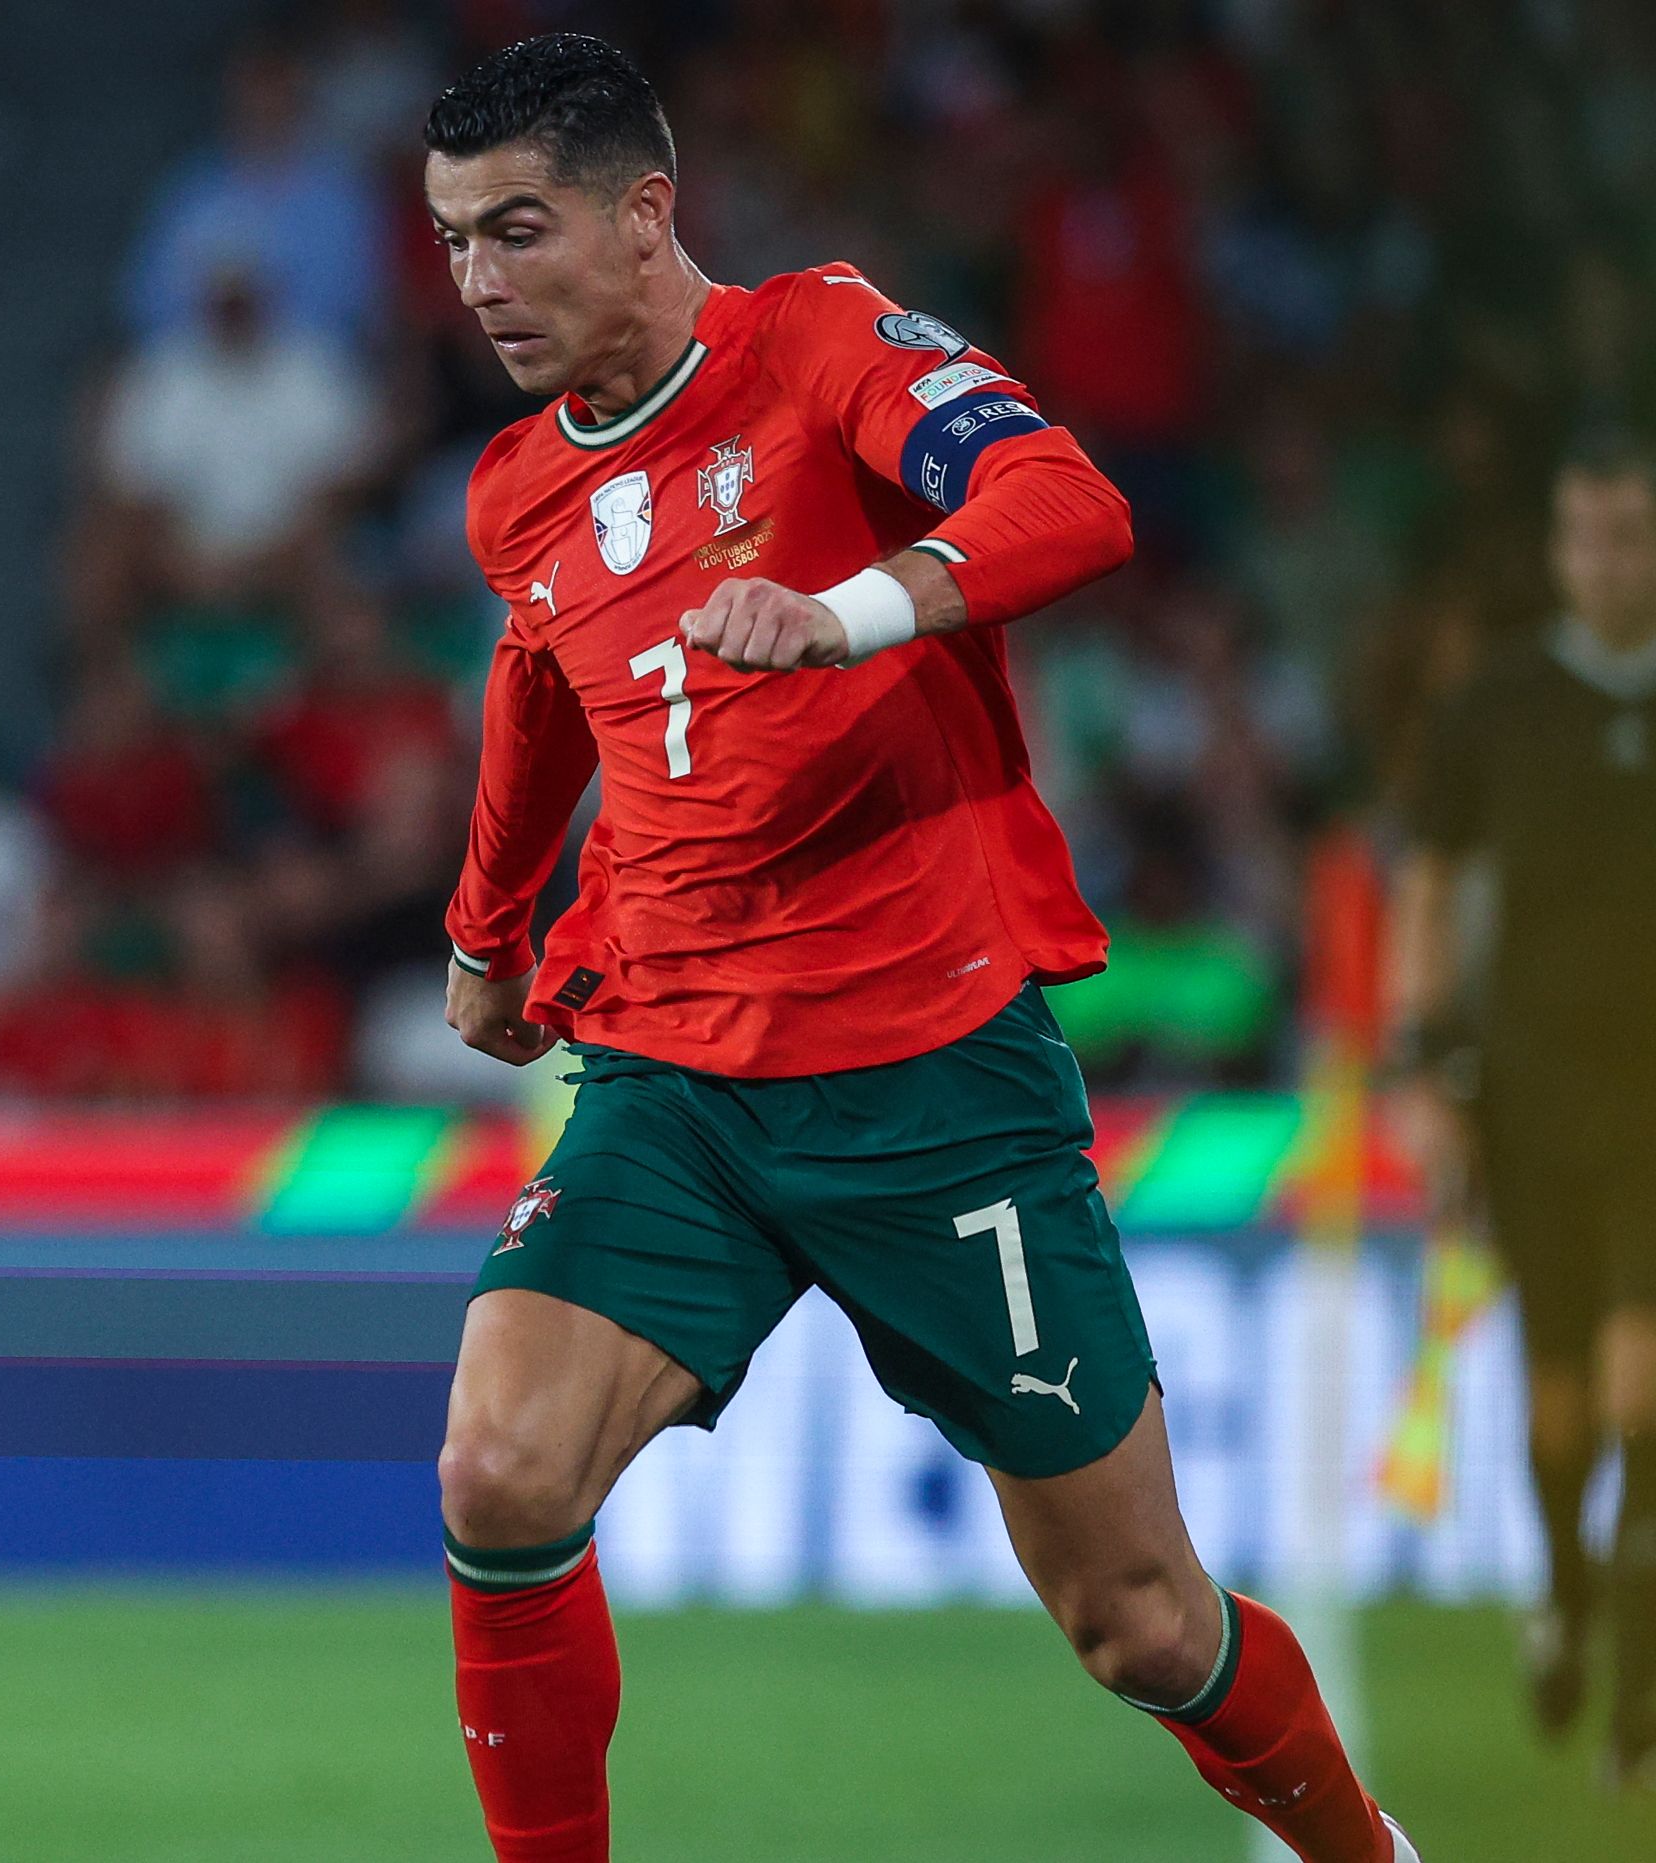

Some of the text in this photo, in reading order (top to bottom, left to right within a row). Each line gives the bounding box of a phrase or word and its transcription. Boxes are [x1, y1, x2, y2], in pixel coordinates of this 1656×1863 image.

[913, 377, 932, 393] UEFA
[698, 560, 710, 571] 14
[709, 540, 753, 566] OUTUBRO
[727, 549, 760, 570] LISBOA
[629, 636, 692, 780] 7
[952, 1197, 1041, 1358] 7
